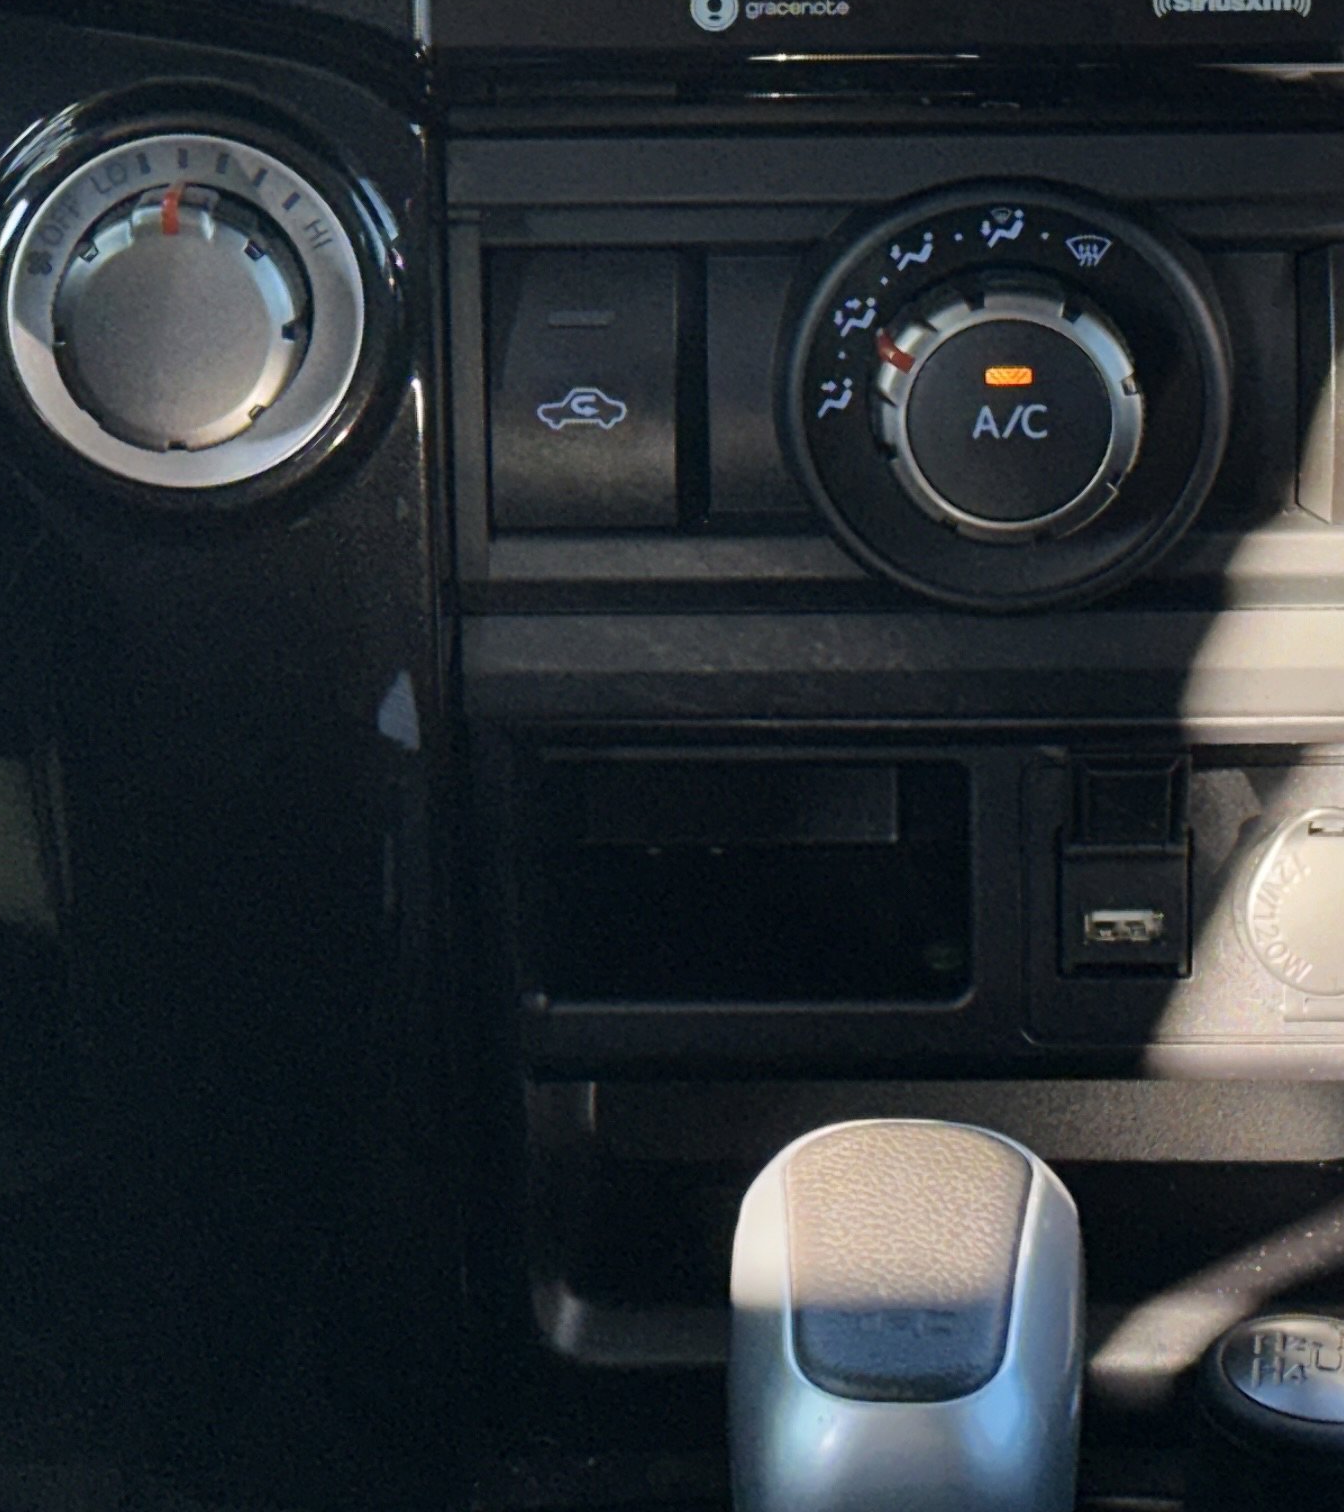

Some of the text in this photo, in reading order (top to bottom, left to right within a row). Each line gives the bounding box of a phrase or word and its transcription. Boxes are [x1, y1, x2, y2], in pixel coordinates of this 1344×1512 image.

[744, 0, 851, 21] gracenote
[89, 163, 128, 195] LO
[42, 197, 82, 246] OFF
[303, 218, 333, 250] HI
[971, 403, 1049, 440] A/C
